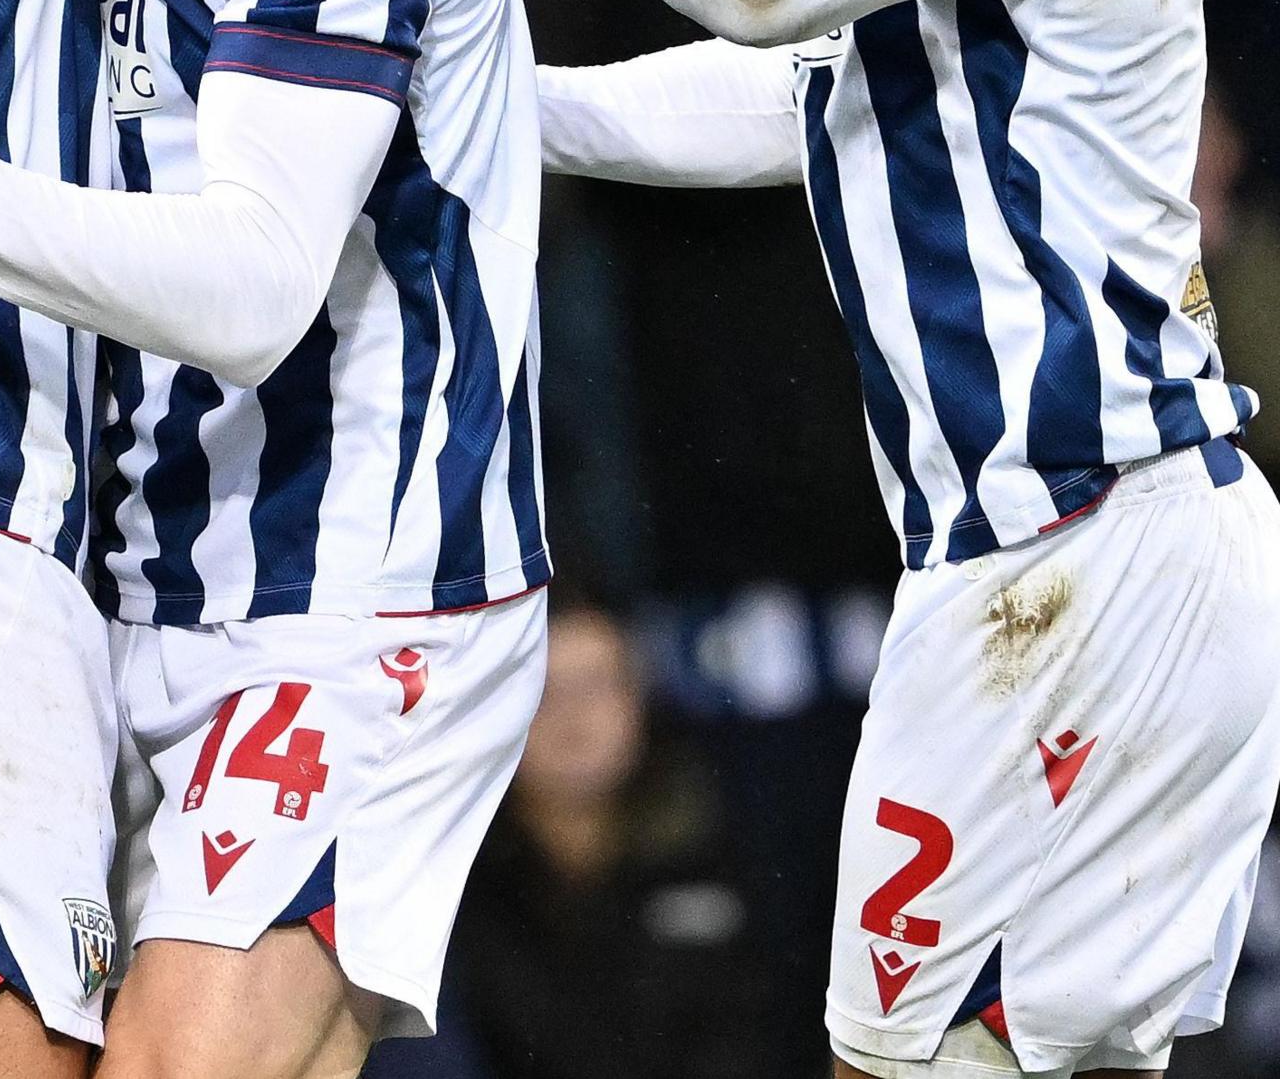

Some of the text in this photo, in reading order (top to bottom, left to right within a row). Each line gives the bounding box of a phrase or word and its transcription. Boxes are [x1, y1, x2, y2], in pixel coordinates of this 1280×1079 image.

[181, 681, 330, 821] 14
[72, 910, 114, 939] ALBION
[860, 796, 954, 948] 2
